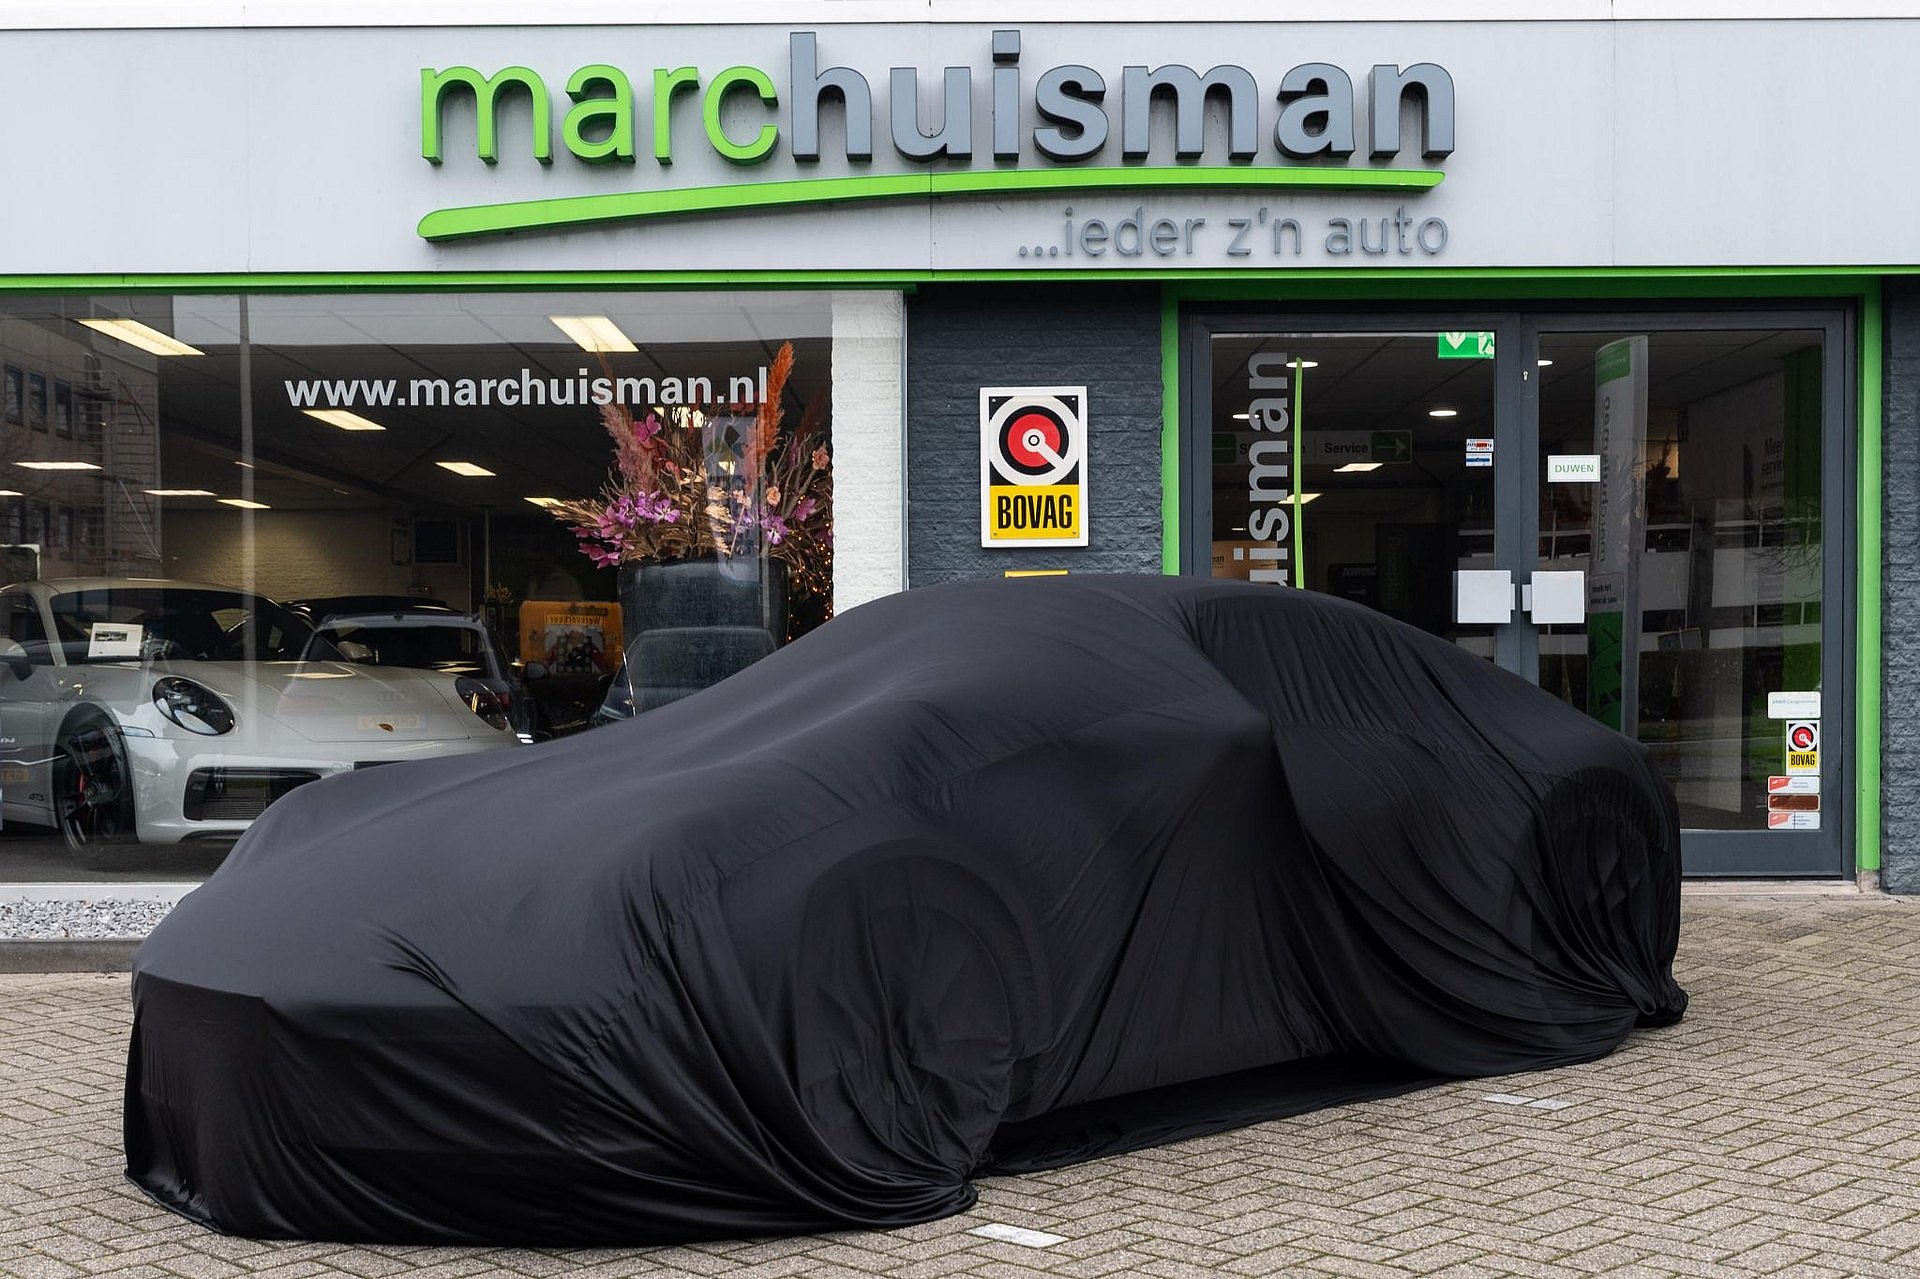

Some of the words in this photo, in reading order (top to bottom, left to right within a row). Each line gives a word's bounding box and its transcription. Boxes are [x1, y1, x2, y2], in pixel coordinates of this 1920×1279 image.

[1018, 206, 1206, 257] ...ieder
[1227, 206, 1302, 257] z'n
[1325, 205, 1449, 257] auto
[285, 366, 768, 407] www.marchuisman.nl
[1324, 442, 1369, 454] Service
[1554, 464, 1594, 473] DUWEN
[997, 494, 1073, 530] BOVAG
[1790, 754, 1815, 766] BOVAG
